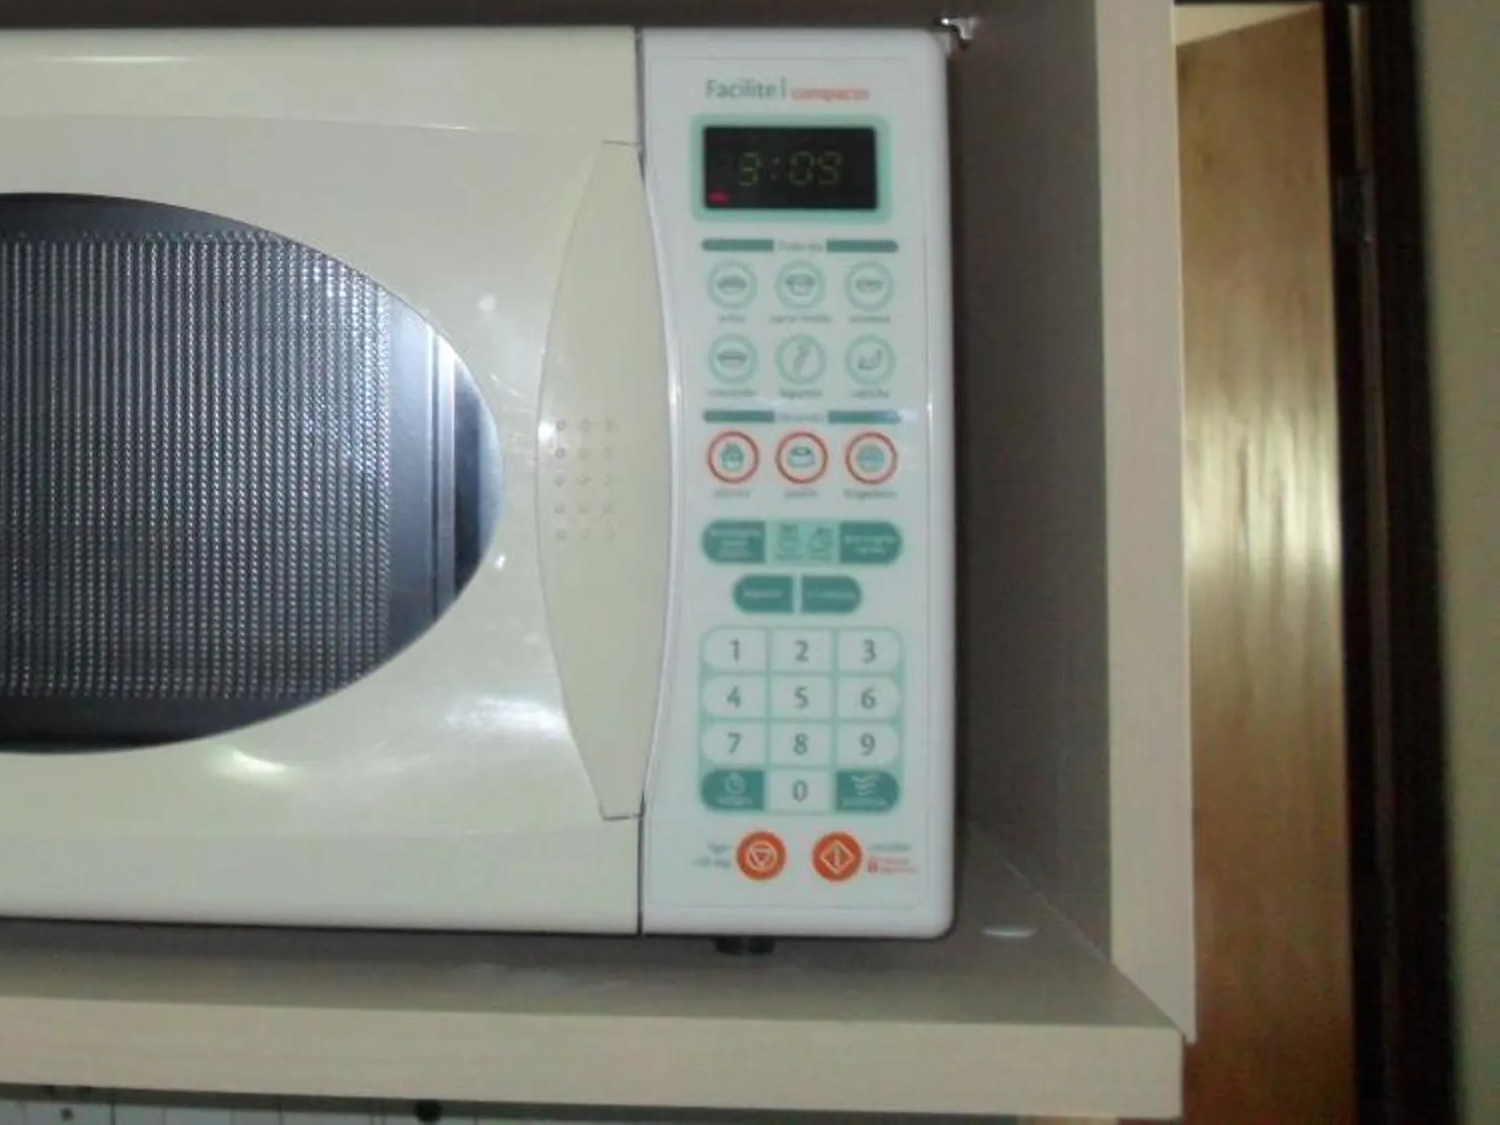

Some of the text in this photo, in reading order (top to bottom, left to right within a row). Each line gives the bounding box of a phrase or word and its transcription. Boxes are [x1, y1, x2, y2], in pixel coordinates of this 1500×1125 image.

[706, 78, 776, 99] Facilite
[729, 639, 741, 665] 1
[795, 639, 809, 662] 2
[861, 639, 877, 664] 3
[726, 685, 741, 709] 4
[794, 686, 809, 709] 5
[860, 687, 876, 710] 6
[727, 732, 741, 755] 7
[793, 732, 809, 755] 8
[859, 732, 876, 756] 9
[791, 779, 808, 802] 0
